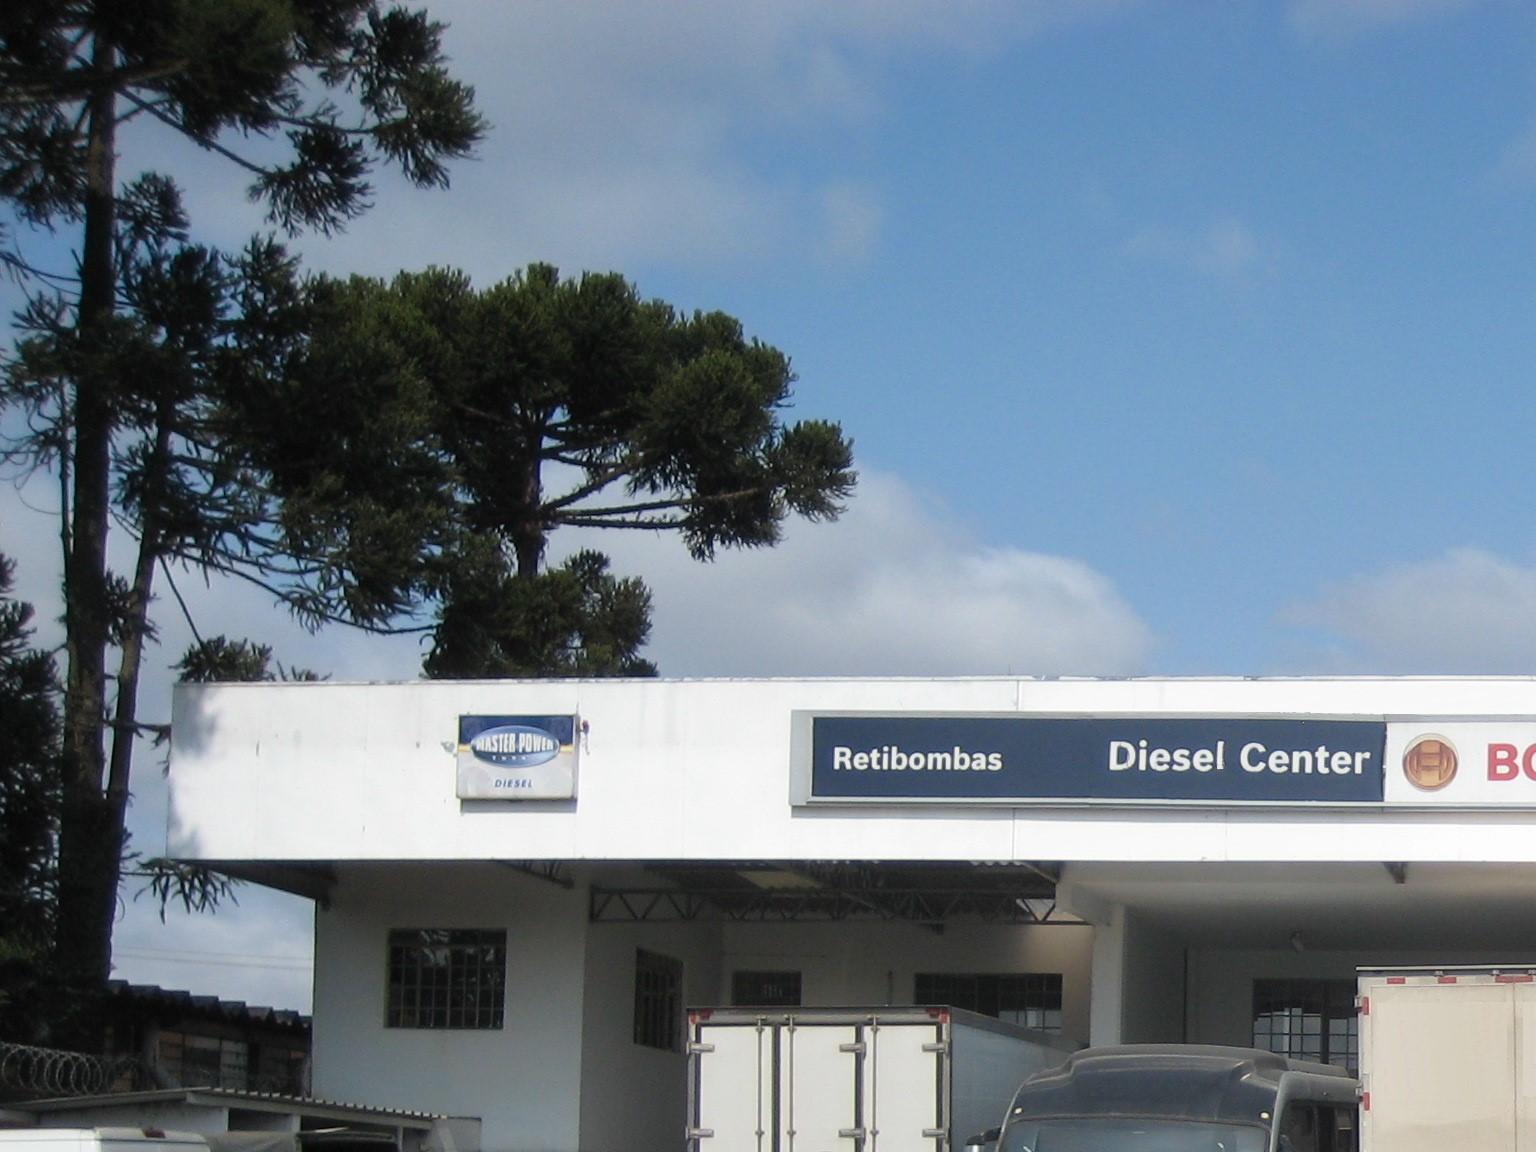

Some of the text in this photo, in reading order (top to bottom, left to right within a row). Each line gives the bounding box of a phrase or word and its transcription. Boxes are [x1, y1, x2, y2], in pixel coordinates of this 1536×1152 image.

[476, 732, 554, 753] MASTER POWER
[833, 746, 1003, 771] Retibombas
[1109, 739, 1371, 774] Diesel Center
[495, 779, 533, 788] DIESEL
